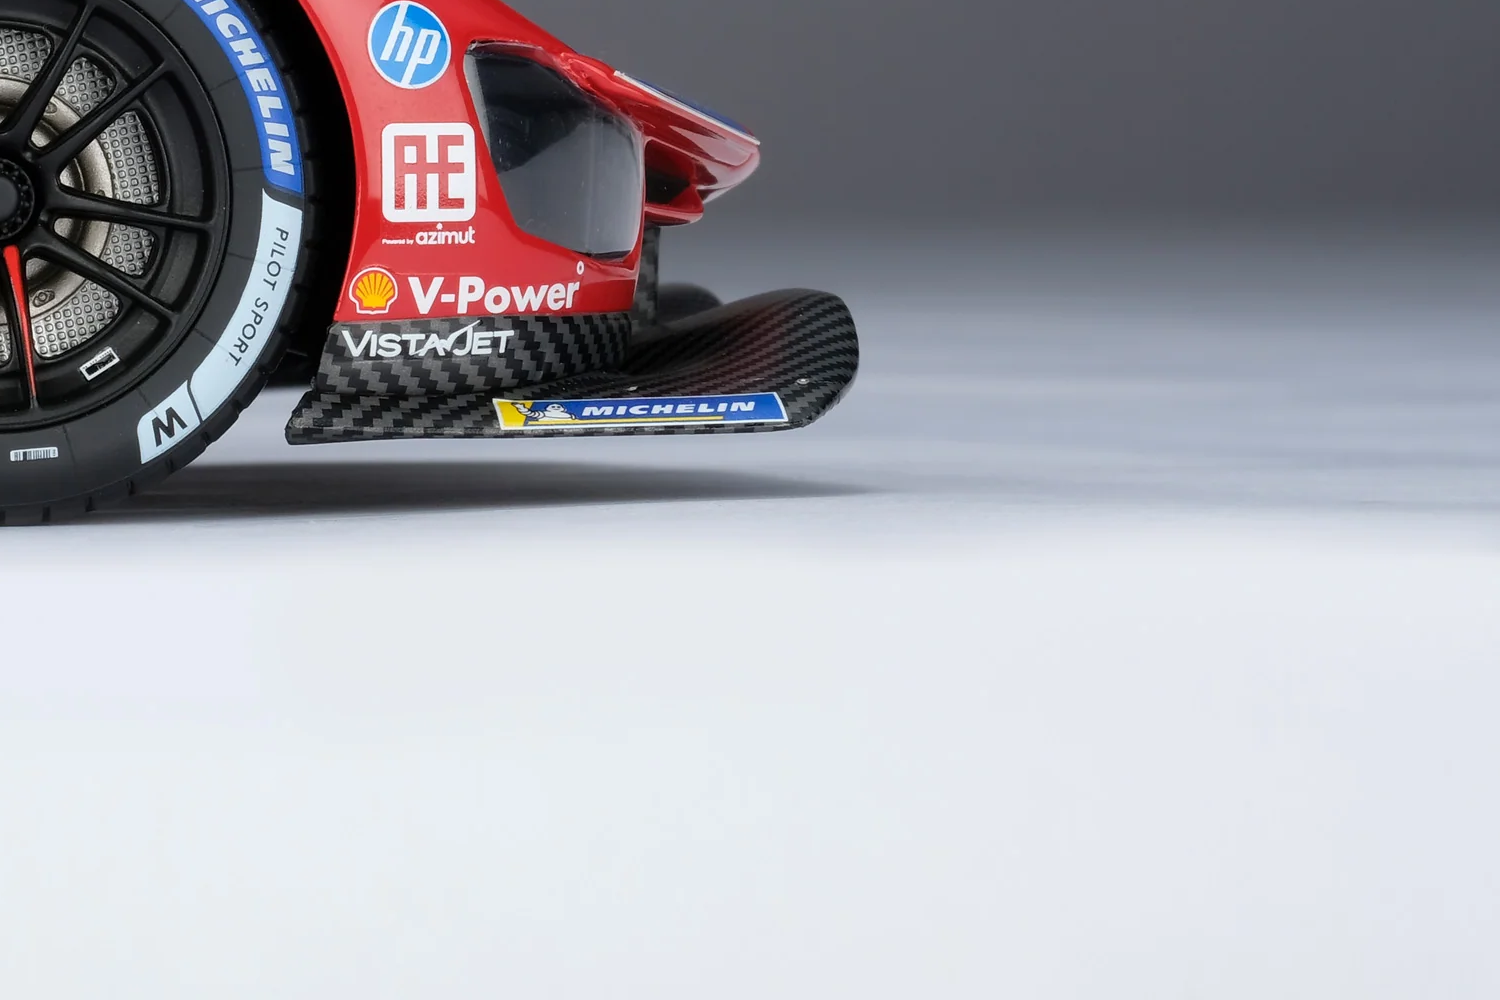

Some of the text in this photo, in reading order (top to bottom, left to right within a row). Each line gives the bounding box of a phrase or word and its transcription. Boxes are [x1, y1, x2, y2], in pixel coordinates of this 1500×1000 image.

[380, 0, 442, 88] hp
[415, 223, 476, 245] azimut
[228, 226, 289, 367] PILOT SPORT
[407, 276, 580, 315] V-Power
[581, 401, 756, 417] MICHELIN
